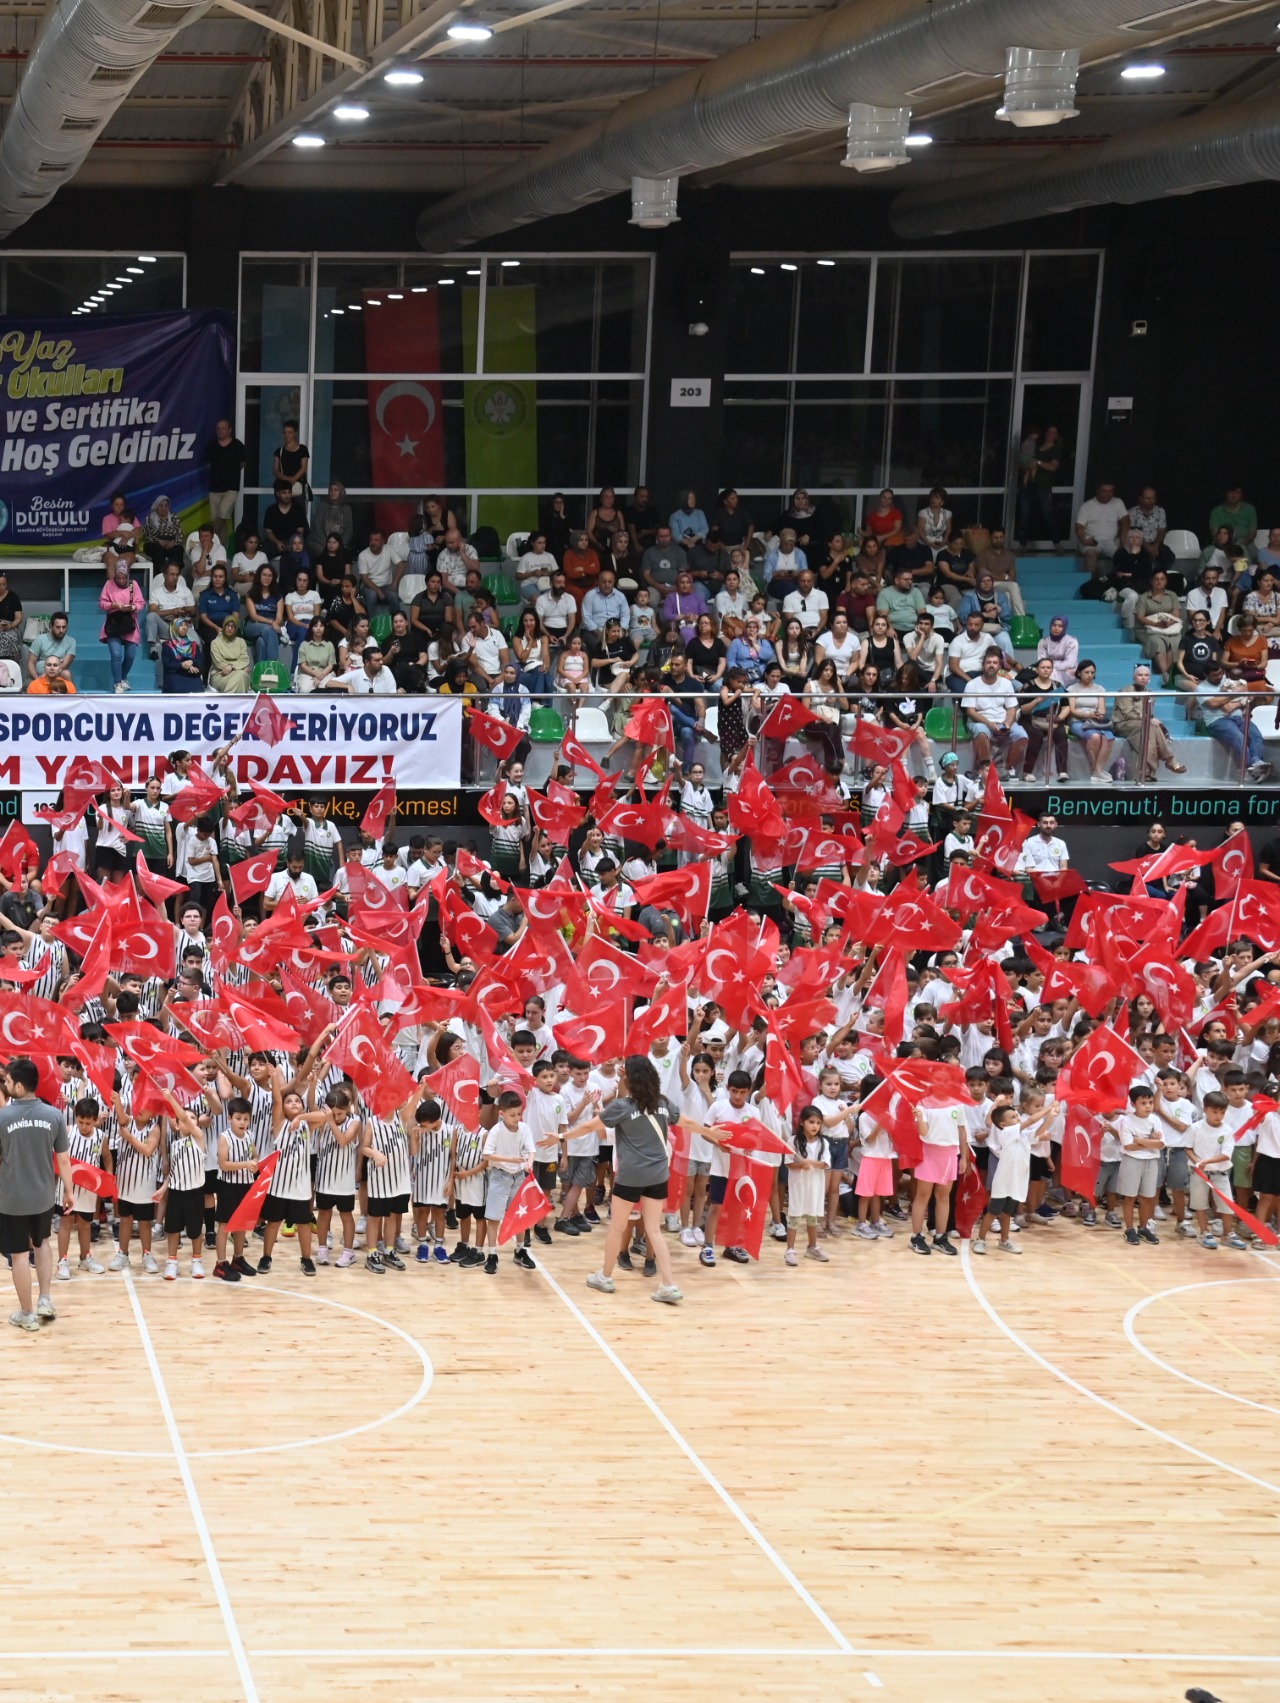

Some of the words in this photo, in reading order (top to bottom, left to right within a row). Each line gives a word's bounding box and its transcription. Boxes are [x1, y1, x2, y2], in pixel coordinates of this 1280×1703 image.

[1, 330, 76, 372] Yaz
[7, 364, 124, 399] Okulları
[680, 387, 701, 397] 203
[6, 409, 38, 433] ve
[43, 397, 161, 431] Sertifika
[0, 438, 60, 476] Hoş
[67, 428, 197, 467] Geldiniz
[30, 496, 75, 511] Besim
[16, 511, 90, 526] DUTLULU
[1048, 795, 1162, 816] Benvenuti,
[1171, 796, 1240, 816] buona
[7, 1117, 33, 1134] MANİSA
[33, 1119, 52, 1131] BBSK
